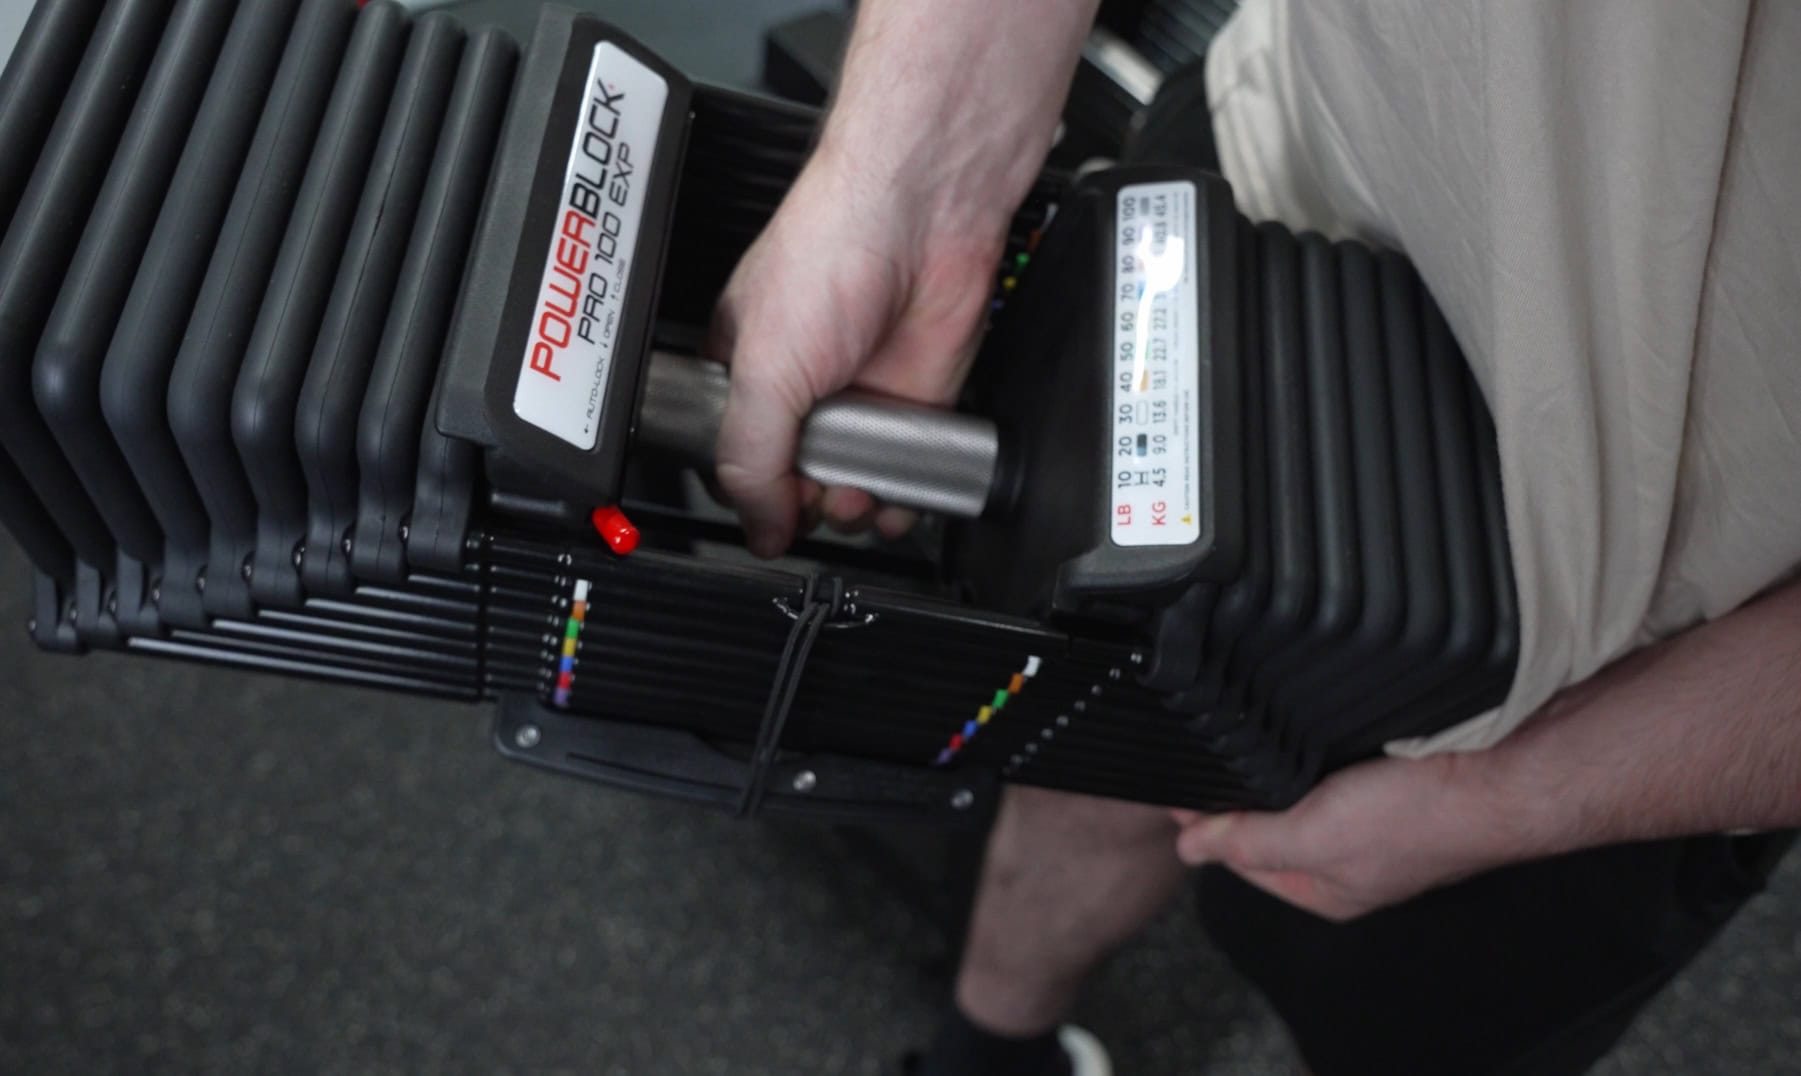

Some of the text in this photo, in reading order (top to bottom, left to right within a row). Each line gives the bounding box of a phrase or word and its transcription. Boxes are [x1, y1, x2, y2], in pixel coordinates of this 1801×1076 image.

[530, 79, 625, 382] POWERBLOCK
[577, 142, 634, 345] PRO 100 EXP
[1152, 308, 1167, 331] 27.2
[587, 259, 627, 420] AUTO-LOCK OPEN CLOSE
[1152, 338, 1167, 361] 22.7
[1117, 197, 1136, 526] LB 10 20 30 40 50 60 70 80 90 100
[1152, 400, 1167, 424] 13.6
[1152, 434, 1166, 455] 9.0
[1152, 468, 1166, 487] 4.5
[1152, 501, 1166, 526] KG
